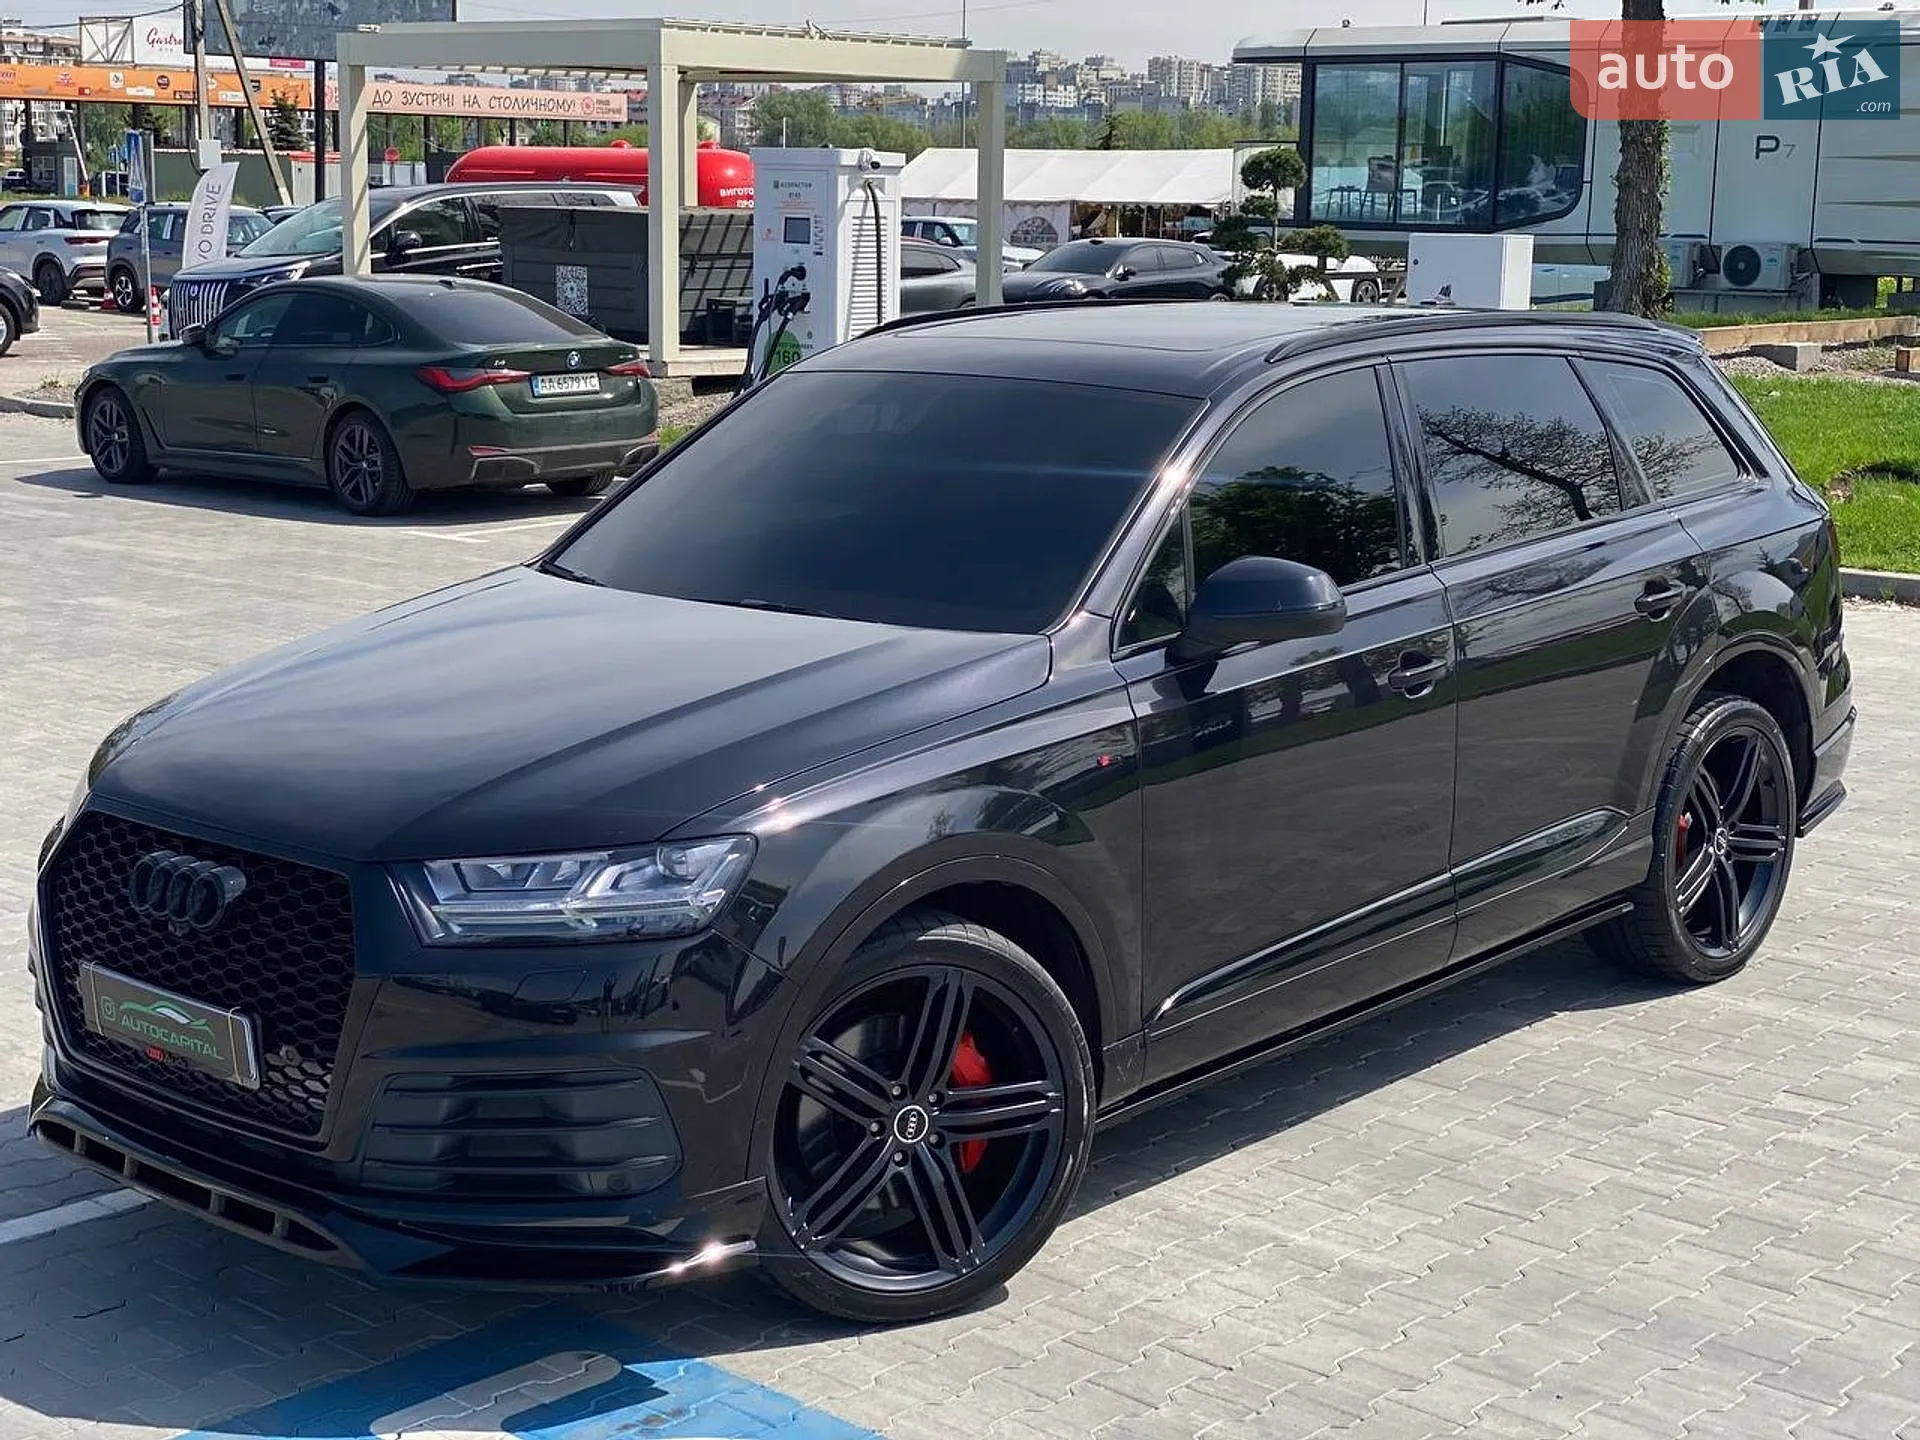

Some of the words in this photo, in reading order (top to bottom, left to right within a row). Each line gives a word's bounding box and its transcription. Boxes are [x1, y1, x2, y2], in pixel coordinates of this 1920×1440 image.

[372, 89, 393, 107] ДО
[400, 90, 454, 109] ЗУСТРІЧІ
[462, 95, 481, 110] НА
[201, 182, 222, 235] DRIVE
[540, 376, 557, 392] AA
[557, 374, 580, 391] 6579
[121, 1014, 225, 1060] AUTOCAPITAL
